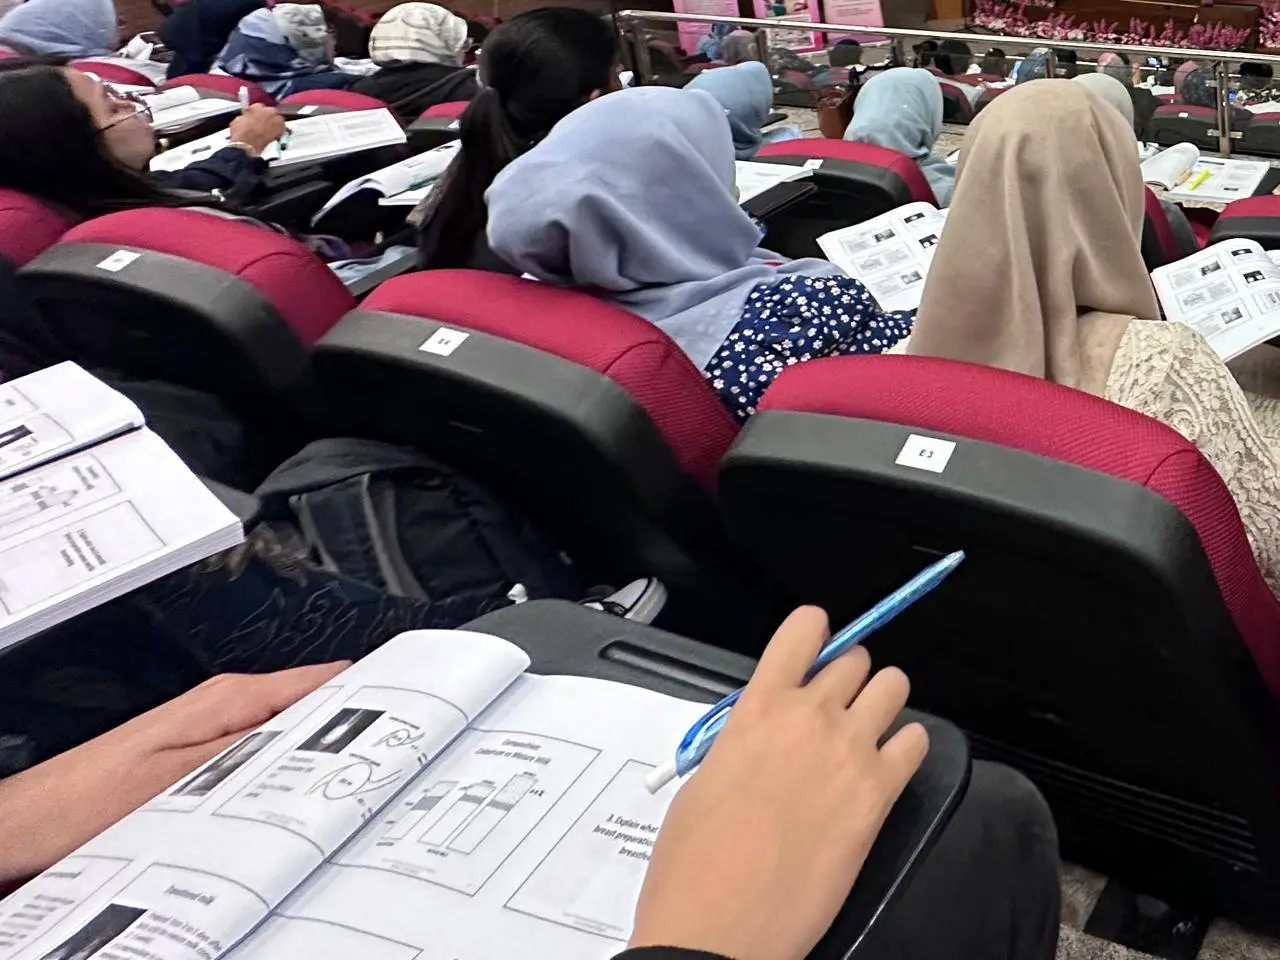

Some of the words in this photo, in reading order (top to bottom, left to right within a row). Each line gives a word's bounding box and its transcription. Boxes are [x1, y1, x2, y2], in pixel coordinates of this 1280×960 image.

[614, 816, 640, 829] Explain
[640, 824, 659, 833] what
[592, 824, 618, 837] breast
[613, 832, 656, 846] preparatio
